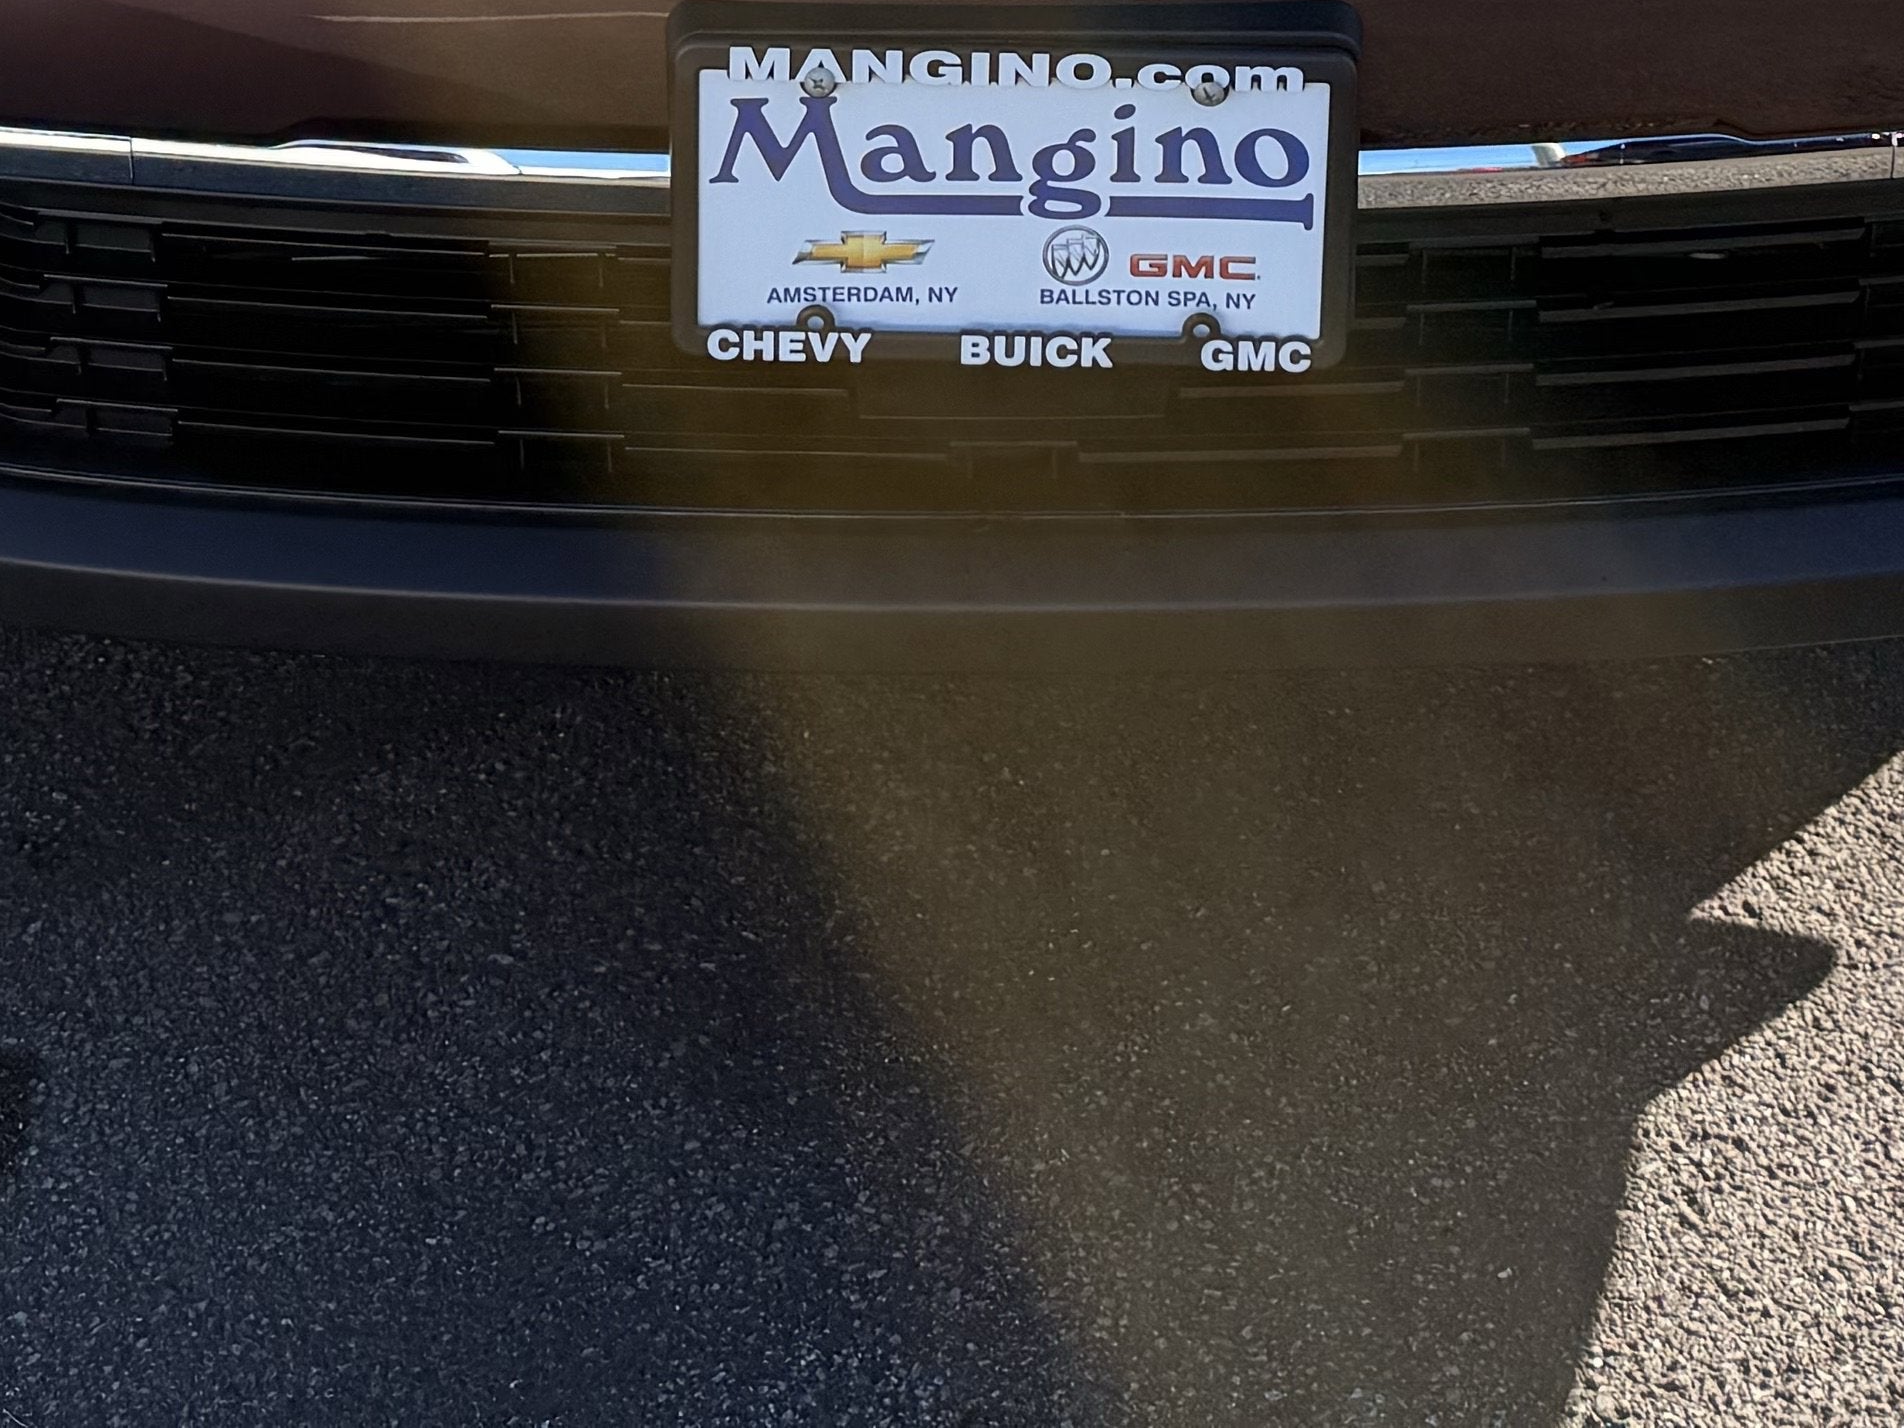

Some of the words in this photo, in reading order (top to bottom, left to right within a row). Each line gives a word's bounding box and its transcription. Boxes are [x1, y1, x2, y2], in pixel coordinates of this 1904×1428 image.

[729, 46, 1304, 92] MANGINO.com
[709, 96, 1314, 231] Mangino
[1129, 253, 1257, 281] GMC
[767, 286, 919, 305] AMSTERDAM,
[928, 286, 958, 303] NY
[1040, 289, 1159, 307] BALLSTON
[1168, 290, 1217, 311] SPA,
[1225, 293, 1256, 310] NY
[707, 329, 872, 363] CHEVY
[960, 334, 1113, 368] BUICK
[1201, 339, 1312, 373] GMC
